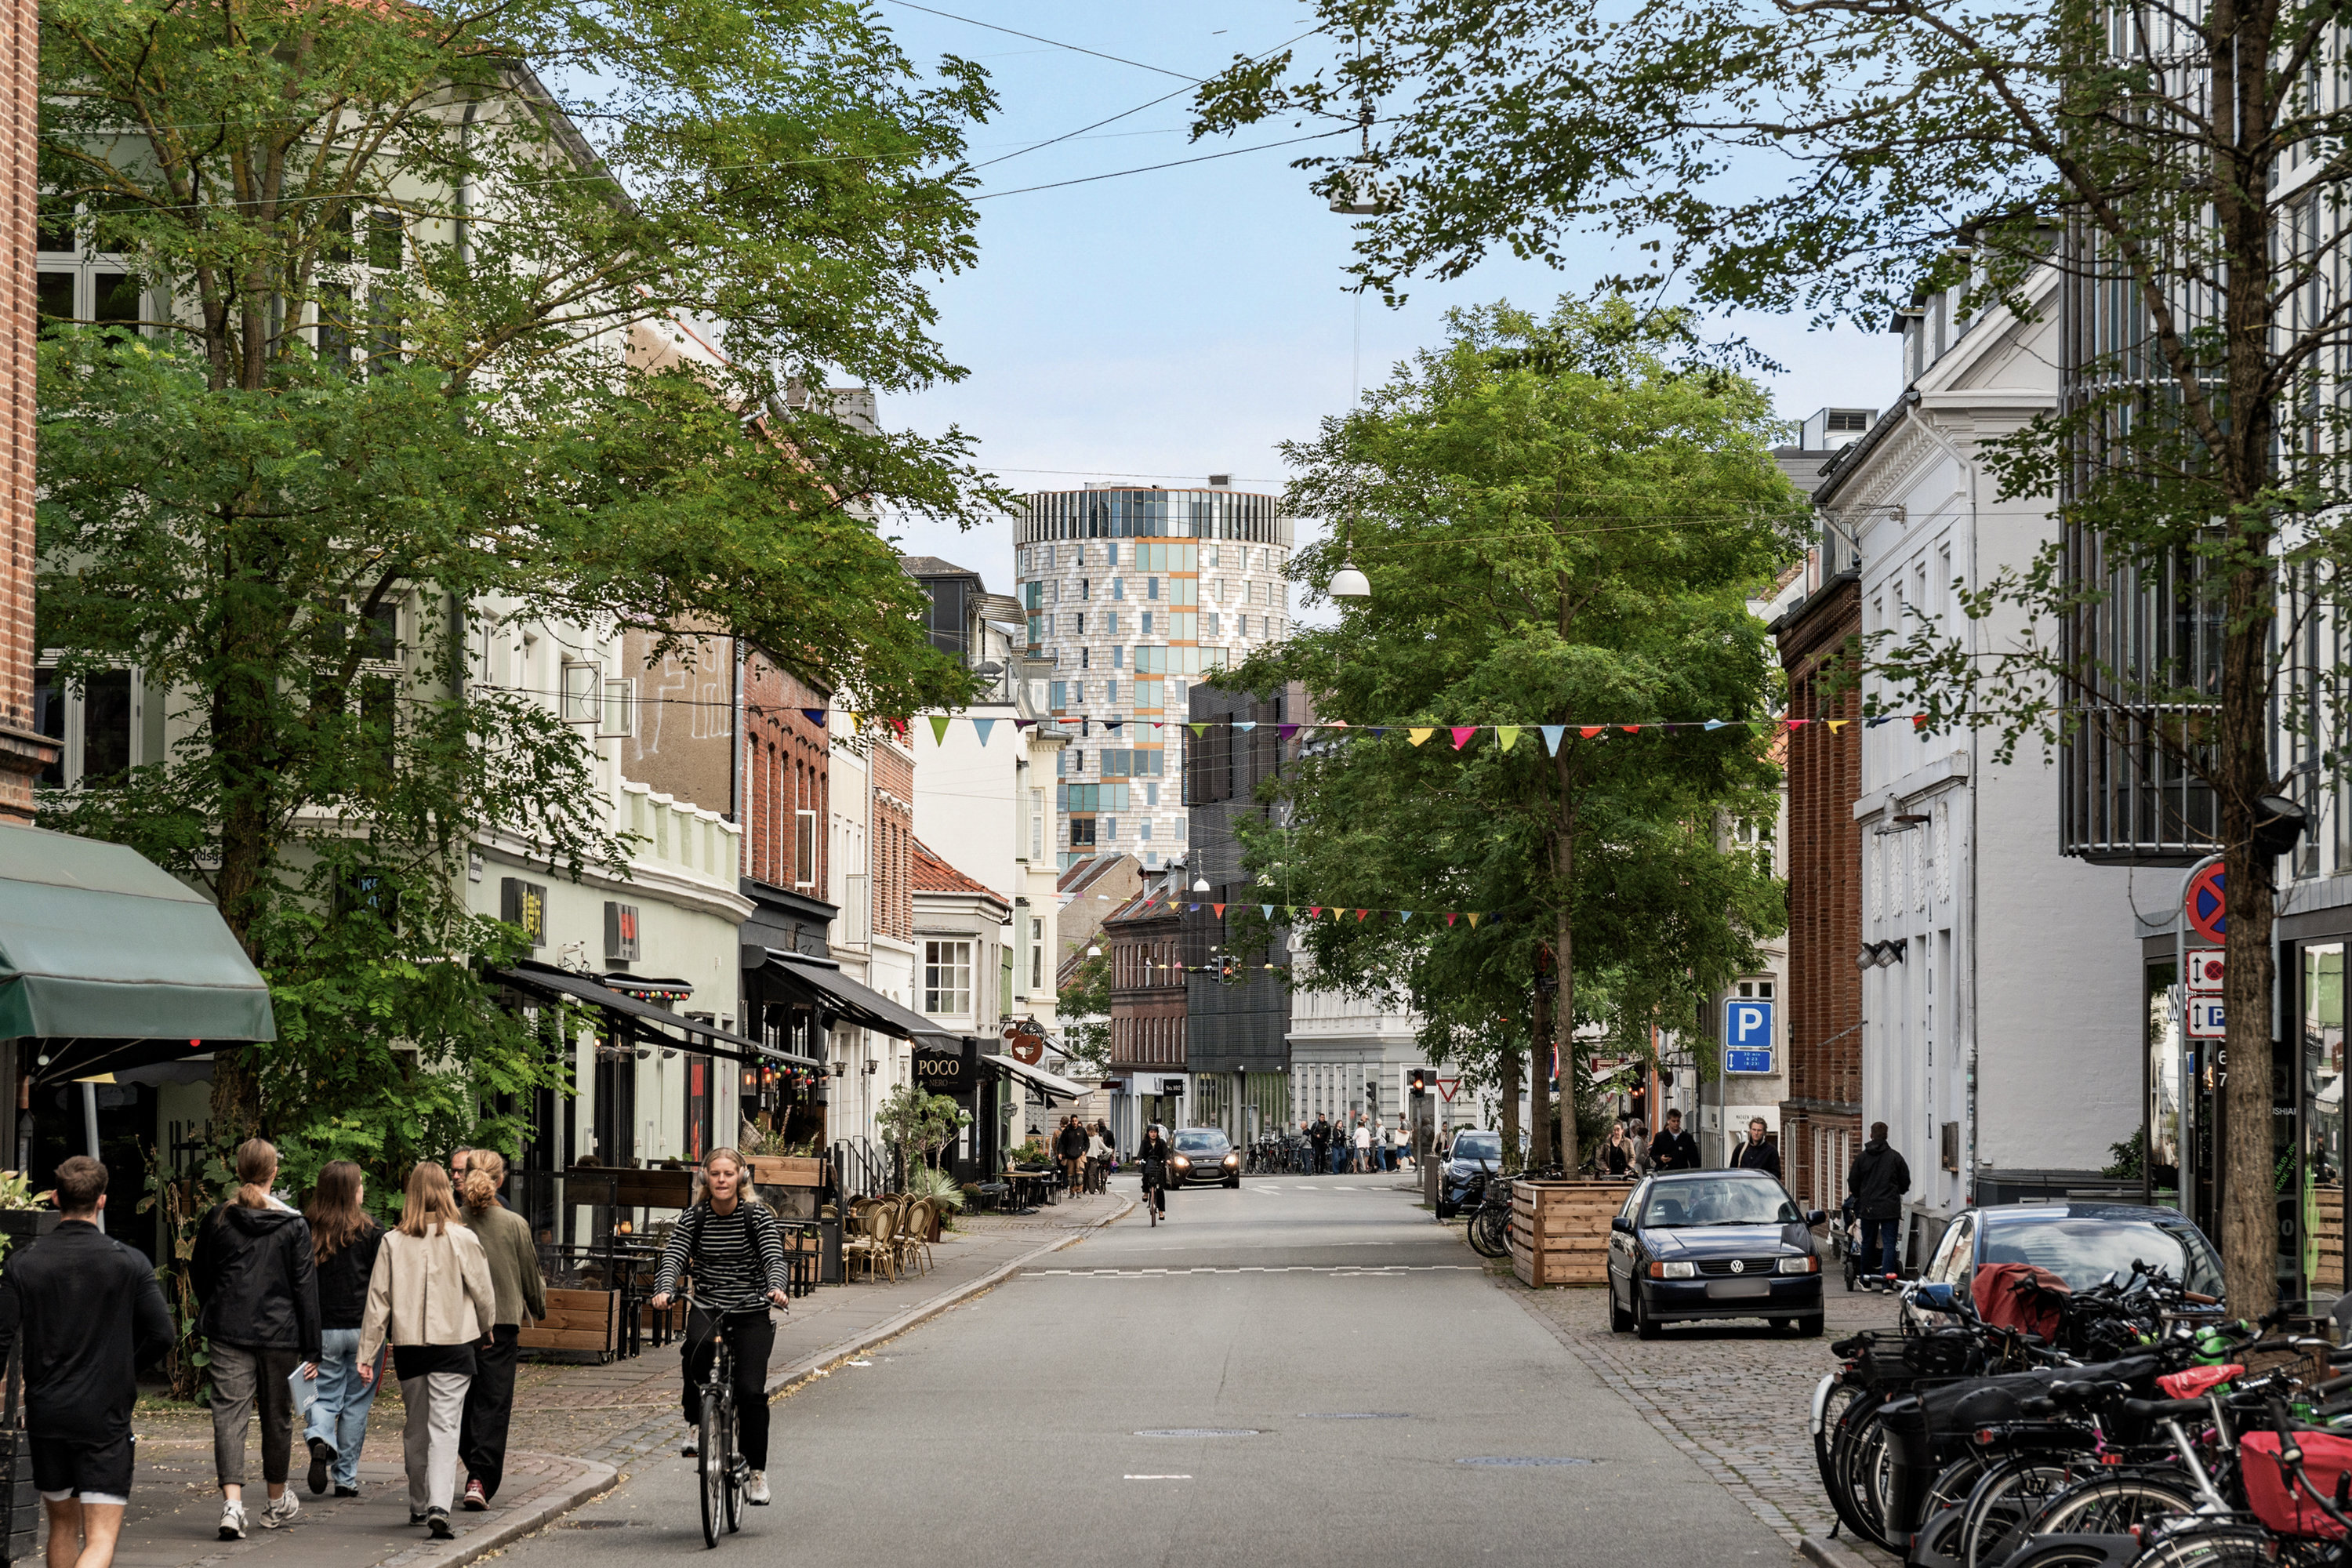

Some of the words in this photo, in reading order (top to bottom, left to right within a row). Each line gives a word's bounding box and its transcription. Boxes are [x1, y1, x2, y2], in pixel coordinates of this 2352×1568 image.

[1738, 1007, 1762, 1041] P
[2213, 1008, 2225, 1025] P
[918, 1060, 959, 1075] POCO
[2274, 1156, 2288, 1178] ILBUD
